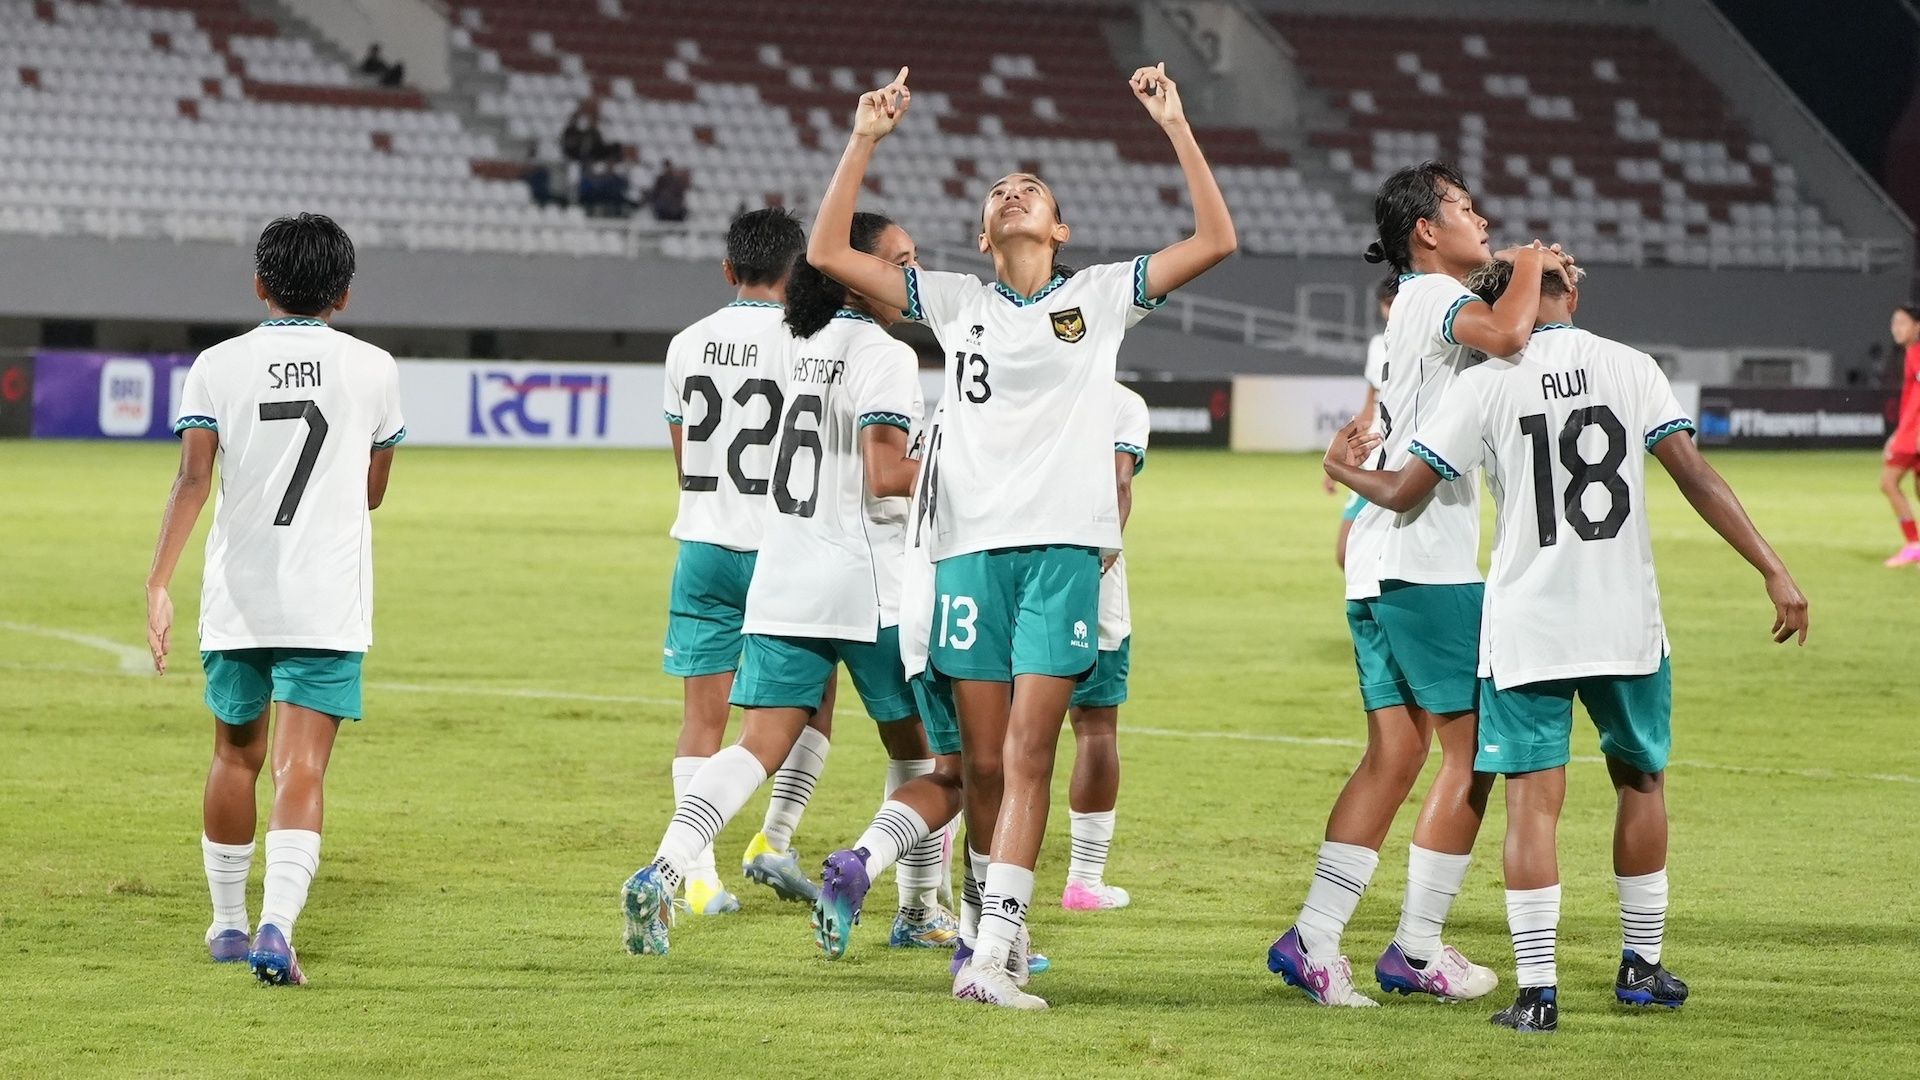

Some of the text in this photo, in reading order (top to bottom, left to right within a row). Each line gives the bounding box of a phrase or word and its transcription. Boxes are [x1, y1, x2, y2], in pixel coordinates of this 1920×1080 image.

[268, 361, 321, 389] SARI
[703, 341, 758, 367] AULIA
[956, 351, 992, 404] 13
[471, 372, 607, 436] RCTI
[1541, 368, 1588, 400] AWI
[259, 400, 329, 526] 7
[682, 375, 784, 495] 22
[772, 394, 823, 518] 6
[1519, 405, 1631, 548] 18
[938, 594, 978, 650] 13
[1071, 639, 1089, 648] MILLS
